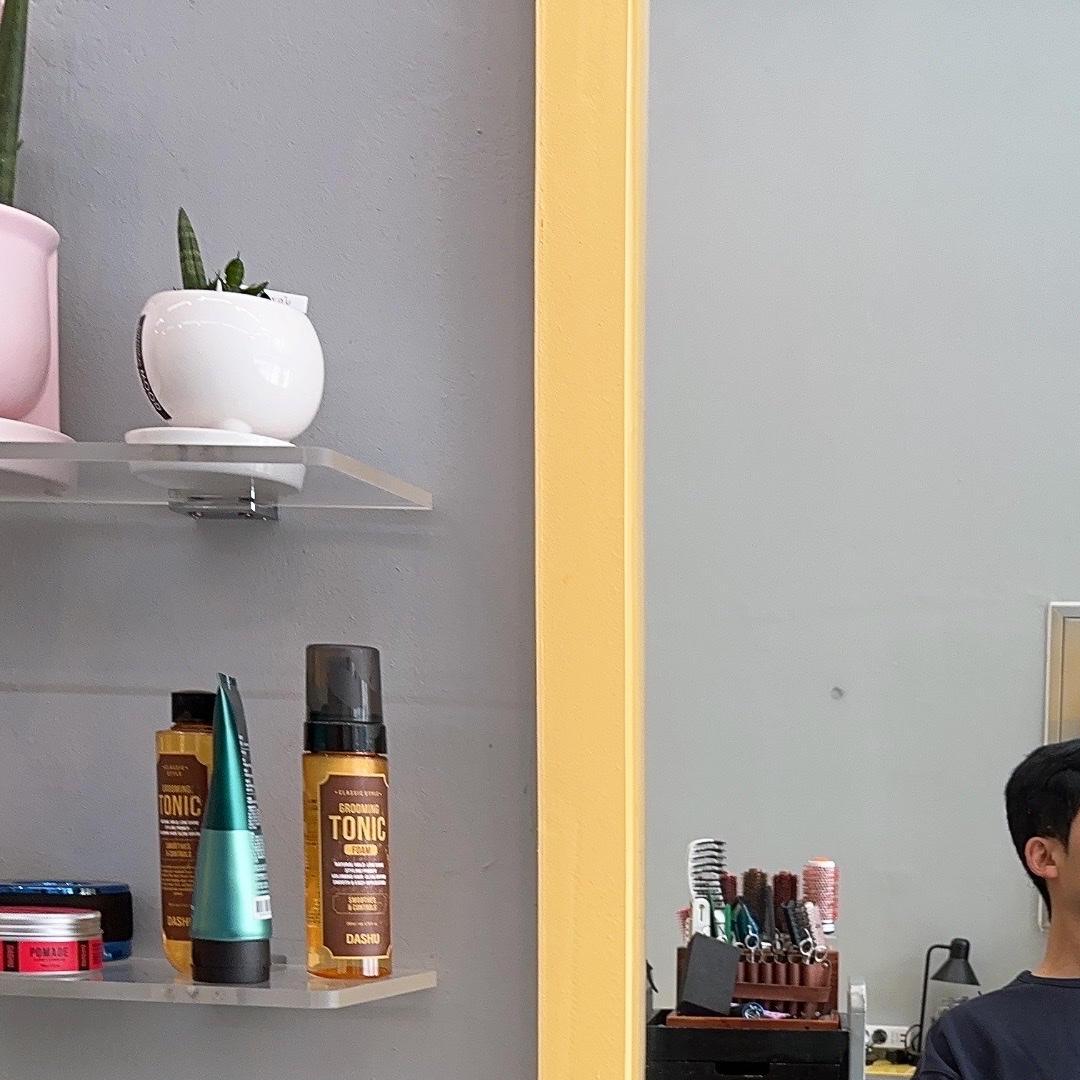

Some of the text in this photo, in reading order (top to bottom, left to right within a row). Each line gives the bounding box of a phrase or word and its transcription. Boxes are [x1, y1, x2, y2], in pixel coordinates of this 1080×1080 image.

[159, 794, 202, 817] TONIC
[338, 802, 380, 814] GROOMING
[328, 815, 386, 841] TONIC
[346, 933, 380, 945] DASHU
[29, 947, 69, 957] POMADE
